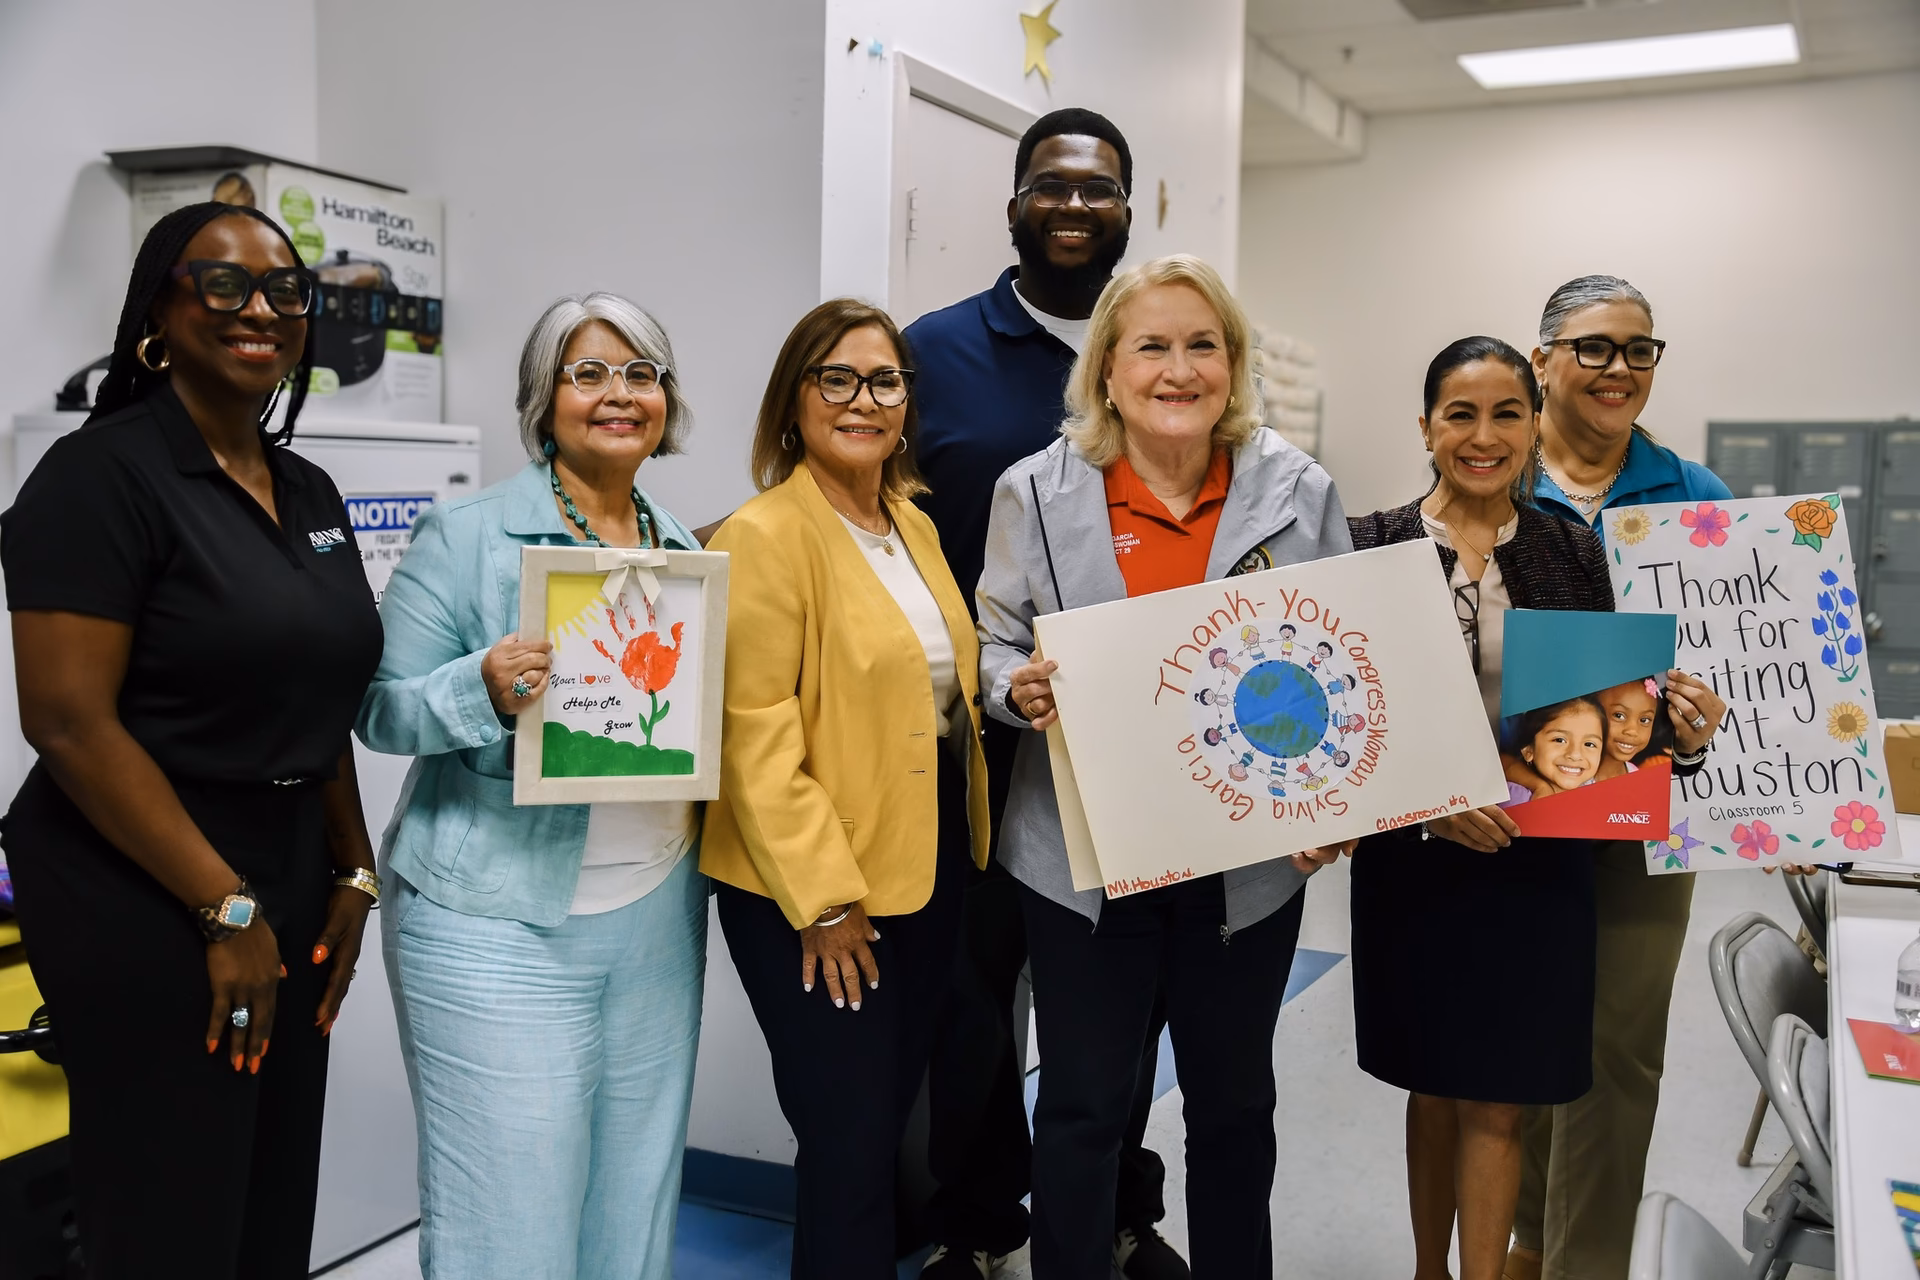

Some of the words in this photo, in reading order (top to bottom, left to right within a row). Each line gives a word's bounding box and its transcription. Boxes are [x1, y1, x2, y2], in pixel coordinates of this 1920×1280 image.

[321, 196, 414, 231] Hamilton
[376, 227, 435, 256] Beach
[1637, 547, 1791, 609] Thank
[1733, 610, 1799, 652] for
[550, 673, 576, 688] Your
[562, 697, 598, 711] Helps
[600, 696, 621, 709] Me
[603, 720, 633, 735] Grow
[1177, 733, 1254, 821] Garcia
[1272, 788, 1349, 823] Sylvia
[1448, 795, 1470, 808] #9
[1708, 804, 1786, 821] Classroom
[1792, 800, 1804, 815] 5
[1606, 813, 1651, 824] AVANCE
